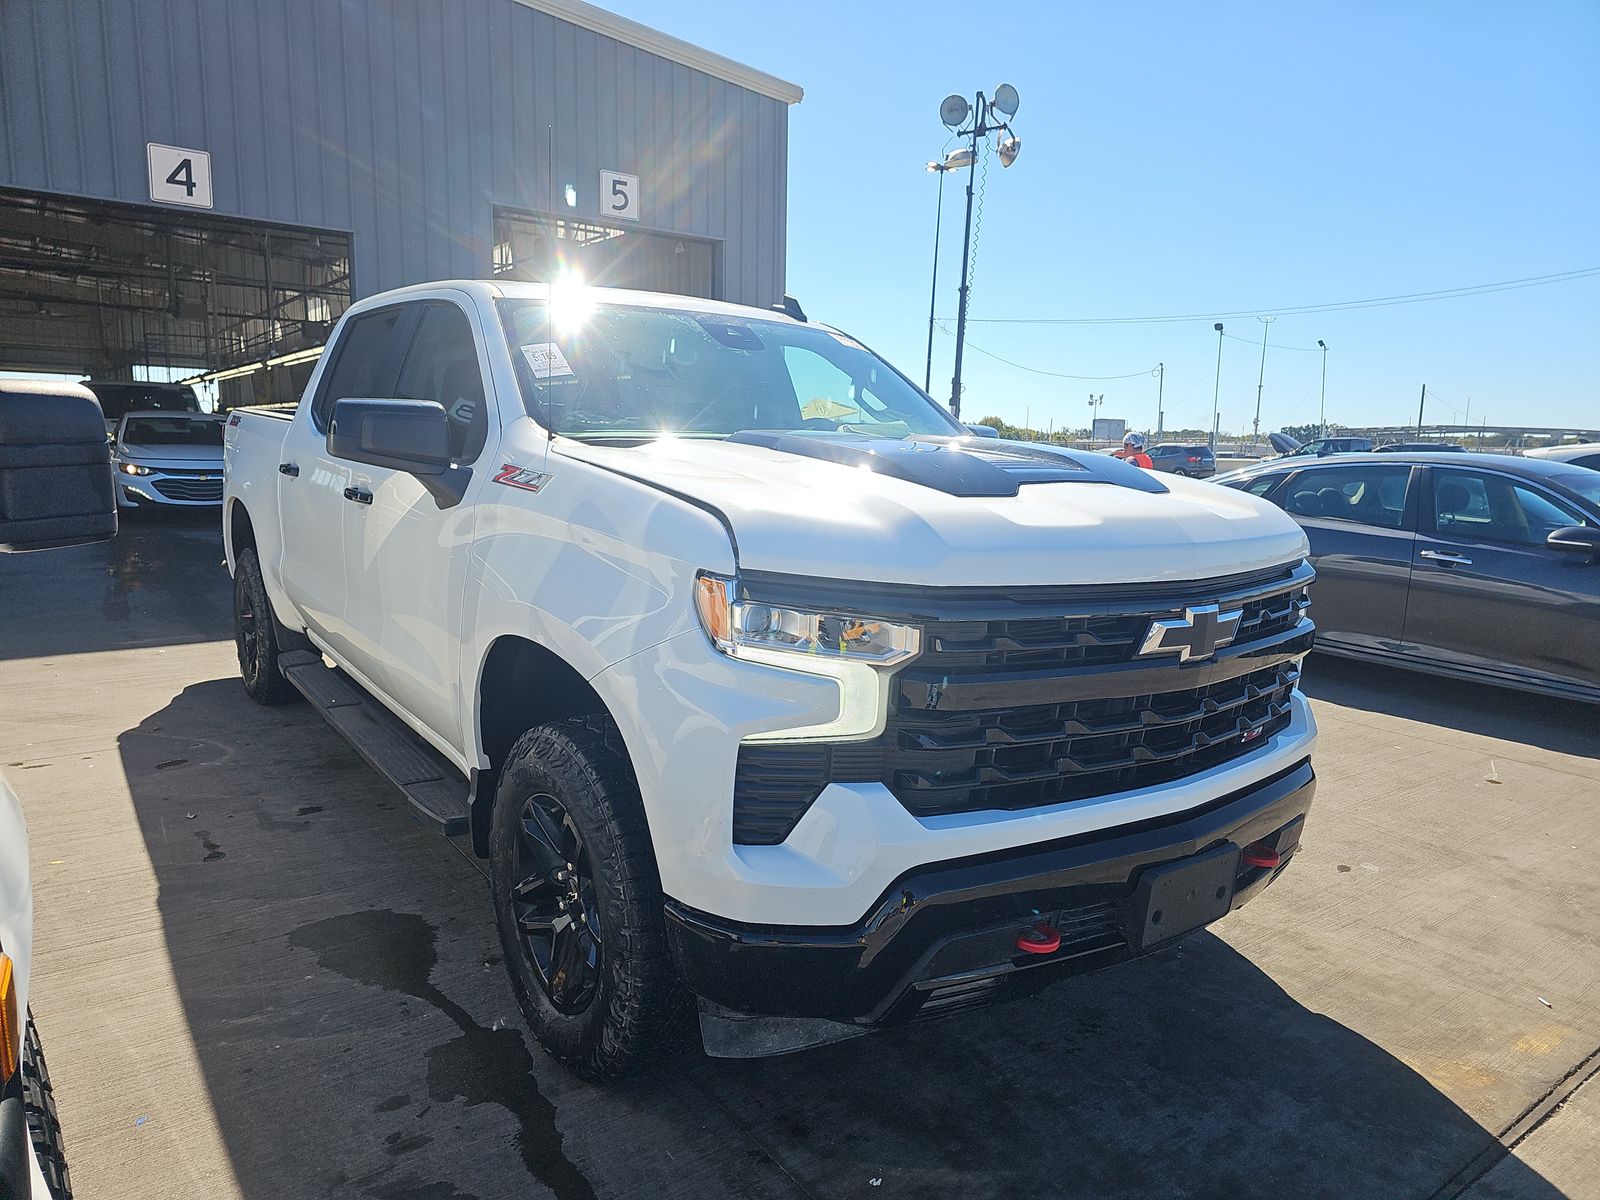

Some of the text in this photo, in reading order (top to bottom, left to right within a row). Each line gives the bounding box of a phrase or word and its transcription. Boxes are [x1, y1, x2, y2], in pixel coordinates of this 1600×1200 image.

[165, 158, 197, 197] 4
[611, 179, 629, 211] 5
[491, 463, 553, 494] Z71
